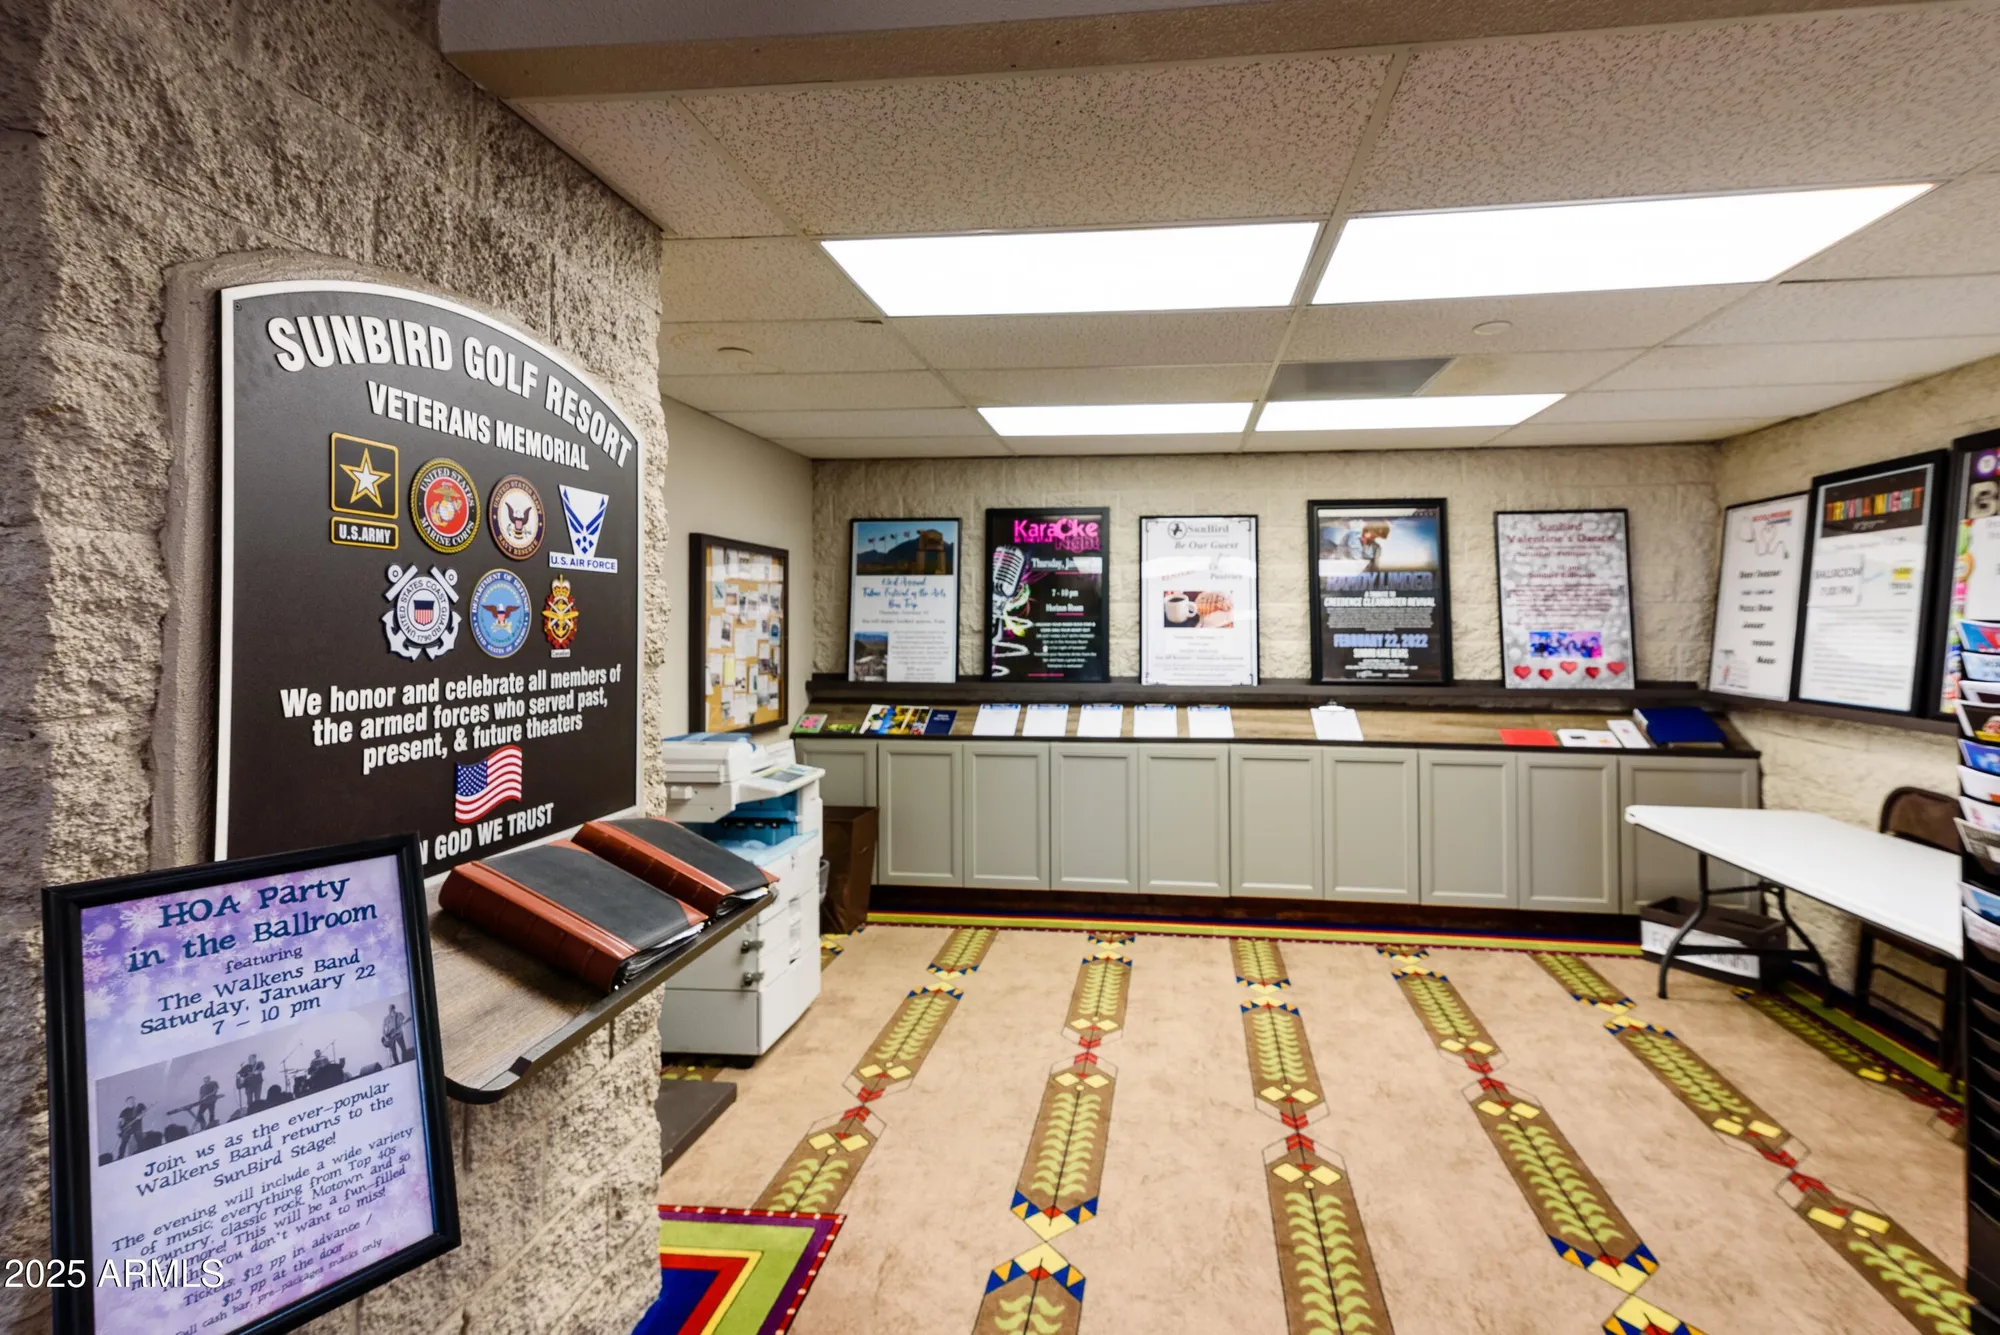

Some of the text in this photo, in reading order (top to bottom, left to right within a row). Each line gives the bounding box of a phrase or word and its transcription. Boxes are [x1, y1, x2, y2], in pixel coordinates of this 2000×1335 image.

[267, 314, 634, 468] SUNBIRD GOLF RESORT
[367, 380, 590, 471] VETERANS MEMORIAL
[420, 468, 475, 507] UNITED STATES
[420, 517, 475, 546] MARINE CORPS
[401, 580, 424, 603] STATES
[426, 580, 446, 603] COAST
[551, 555, 616, 570] U.S. AIR FORCE
[280, 663, 622, 719] We honor and celebrate all members of
[312, 686, 608, 747] the armed forces who served past,
[363, 714, 583, 775] present, & future theaters
[434, 827, 473, 861] GOD
[477, 817, 504, 847] WE
[507, 802, 554, 837] TRUST
[158, 877, 350, 929] HOA Party
[127, 904, 378, 973] in the Ballroom
[225, 946, 303, 975] featuring
[141, 964, 376, 1036] Saturday, January 22
[158, 948, 361, 1013] The Walkens Band
[212, 1019, 225, 1035] 7
[260, 1005, 280, 1023] 10
[290, 996, 321, 1018] pm
[135, 1095, 394, 1197] Walkens Band returns to the
[143, 1155, 186, 1178] Join
[196, 1143, 215, 1158] us
[224, 1135, 244, 1149] as
[252, 1122, 280, 1139] the
[213, 1131, 337, 1187] SunBird Stage!
[112, 1126, 414, 1252] The evening will include a wide variety
[140, 1239, 158, 1256] of
[221, 1184, 303, 1223] everything
[310, 1168, 342, 1189] from
[349, 1156, 372, 1171] Top
[377, 1145, 397, 1160] 40s
[221, 1211, 267, 1237] classic
[311, 1173, 364, 1200] Motown
[371, 1157, 393, 1175] and
[399, 1153, 411, 1164] so
[251, 1230, 288, 1252] don't
[296, 1212, 331, 1233] want
[338, 1205, 350, 1216] to
[356, 1187, 386, 1208] miss!
[185, 1239, 227, 1268] more!
[234, 1224, 267, 1246] This
[274, 1209, 301, 1229] will
[308, 1200, 323, 1214] be
[329, 1195, 338, 1206] a
[242, 1264, 263, 1282] $12
[269, 1254, 286, 1271] pp
[292, 1245, 305, 1258] in
[312, 1221, 360, 1248] advance
[202, 1311, 228, 1328] cash
[328, 1249, 359, 1269] snacks
[362, 1238, 384, 1253] only
[222, 1242, 345, 1307] $15 pp at the door
